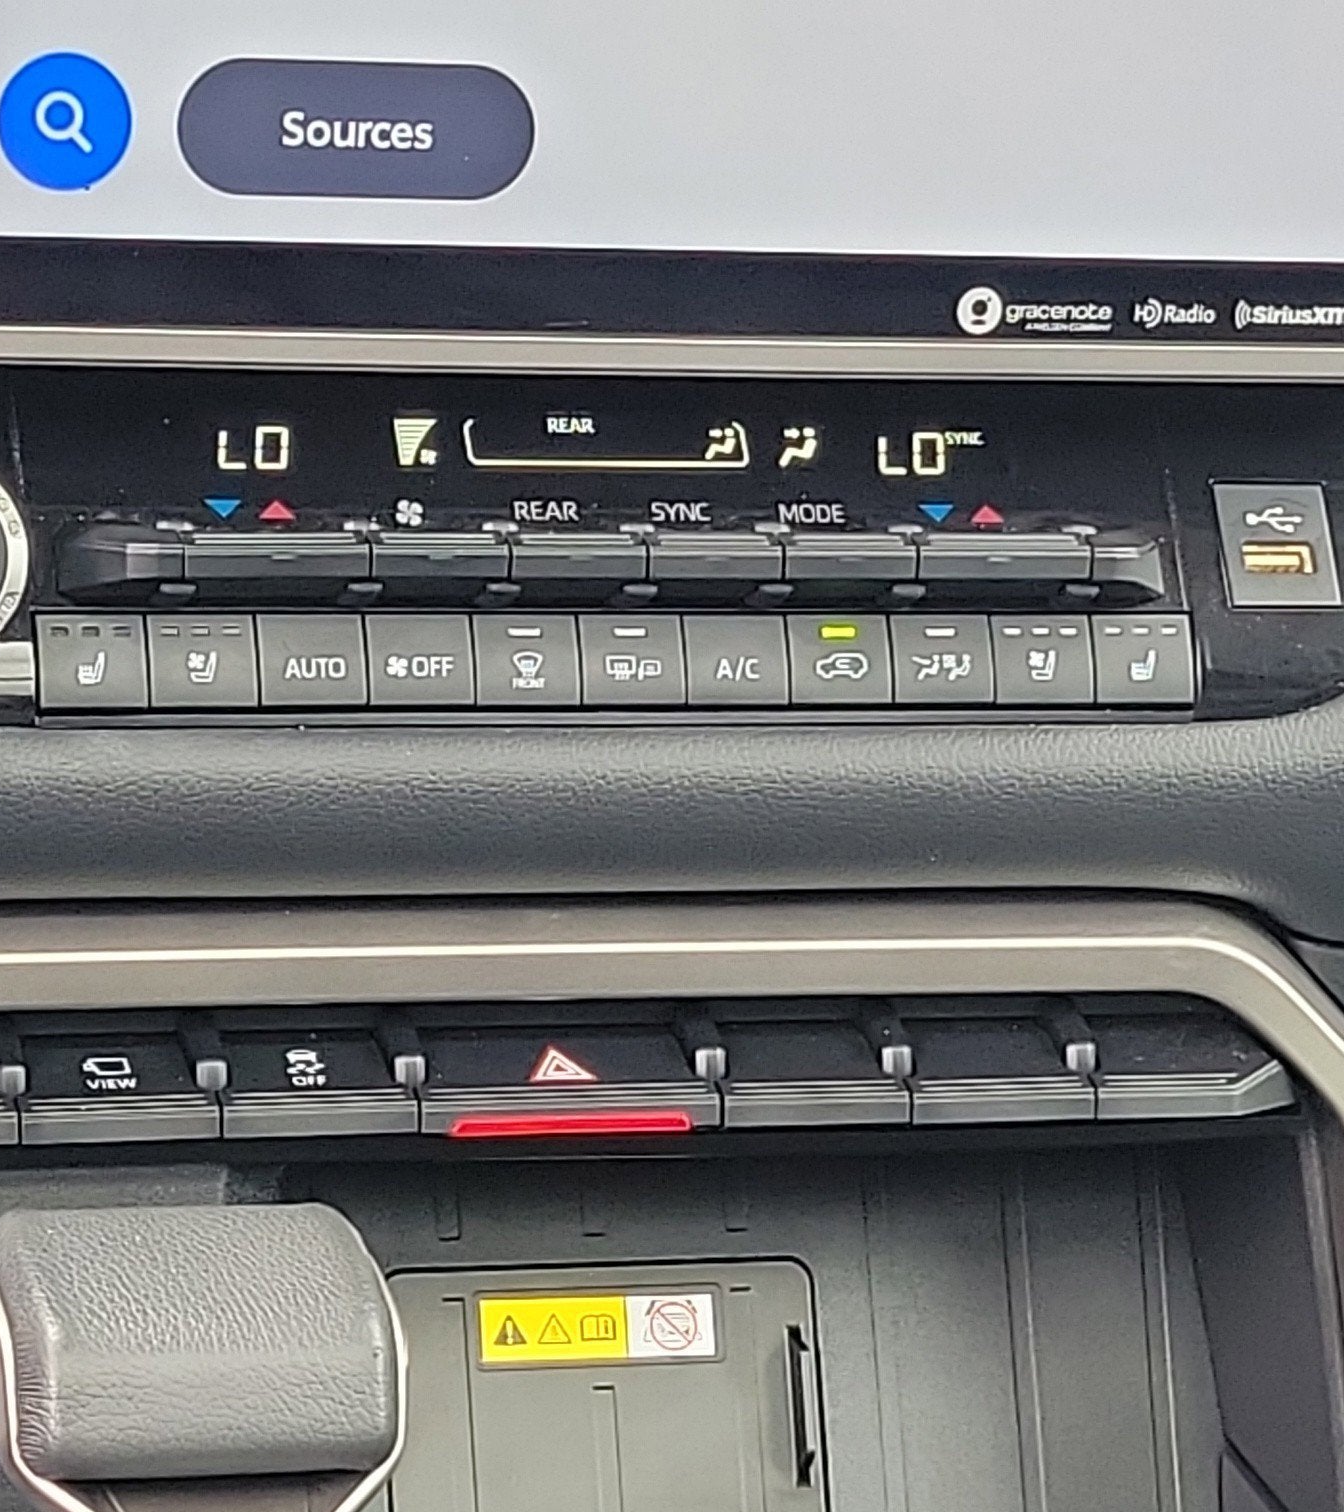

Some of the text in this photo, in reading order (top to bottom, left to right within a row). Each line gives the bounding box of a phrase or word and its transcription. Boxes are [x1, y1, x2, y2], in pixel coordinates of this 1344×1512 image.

[280, 109, 435, 152] Sources
[1004, 302, 1114, 324] gracenote
[546, 417, 596, 435] REAR
[513, 500, 580, 522] REAR
[650, 501, 712, 522] SYNC
[777, 502, 847, 525] MODE
[284, 656, 348, 680] AUTO
[411, 655, 456, 677] OFF
[716, 656, 760, 682] A/C
[85, 1076, 137, 1091] VIEW
[292, 1074, 327, 1087] OFF
